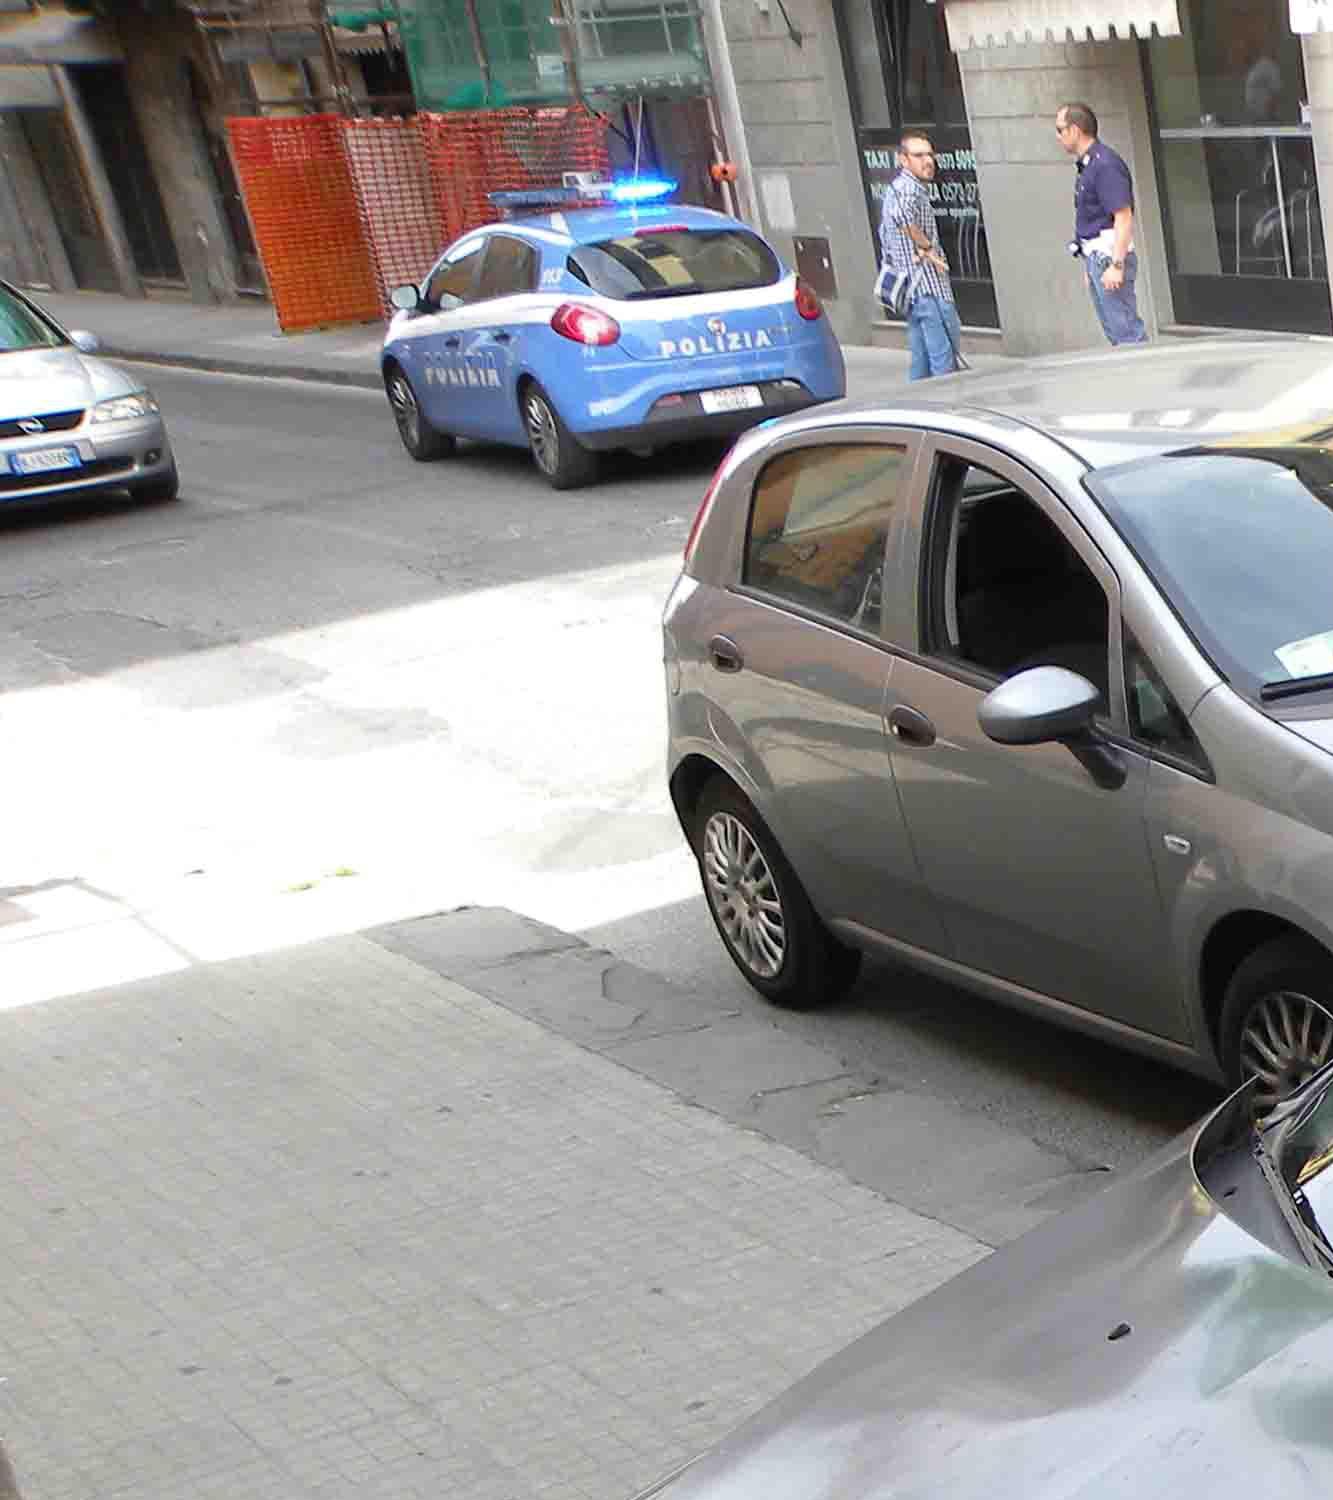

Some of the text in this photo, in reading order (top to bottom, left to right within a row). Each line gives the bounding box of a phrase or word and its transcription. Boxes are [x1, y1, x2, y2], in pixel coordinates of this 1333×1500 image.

[863, 149, 890, 169] TAXI
[941, 183, 964, 202] 0573
[658, 328, 772, 359] POLIZIA
